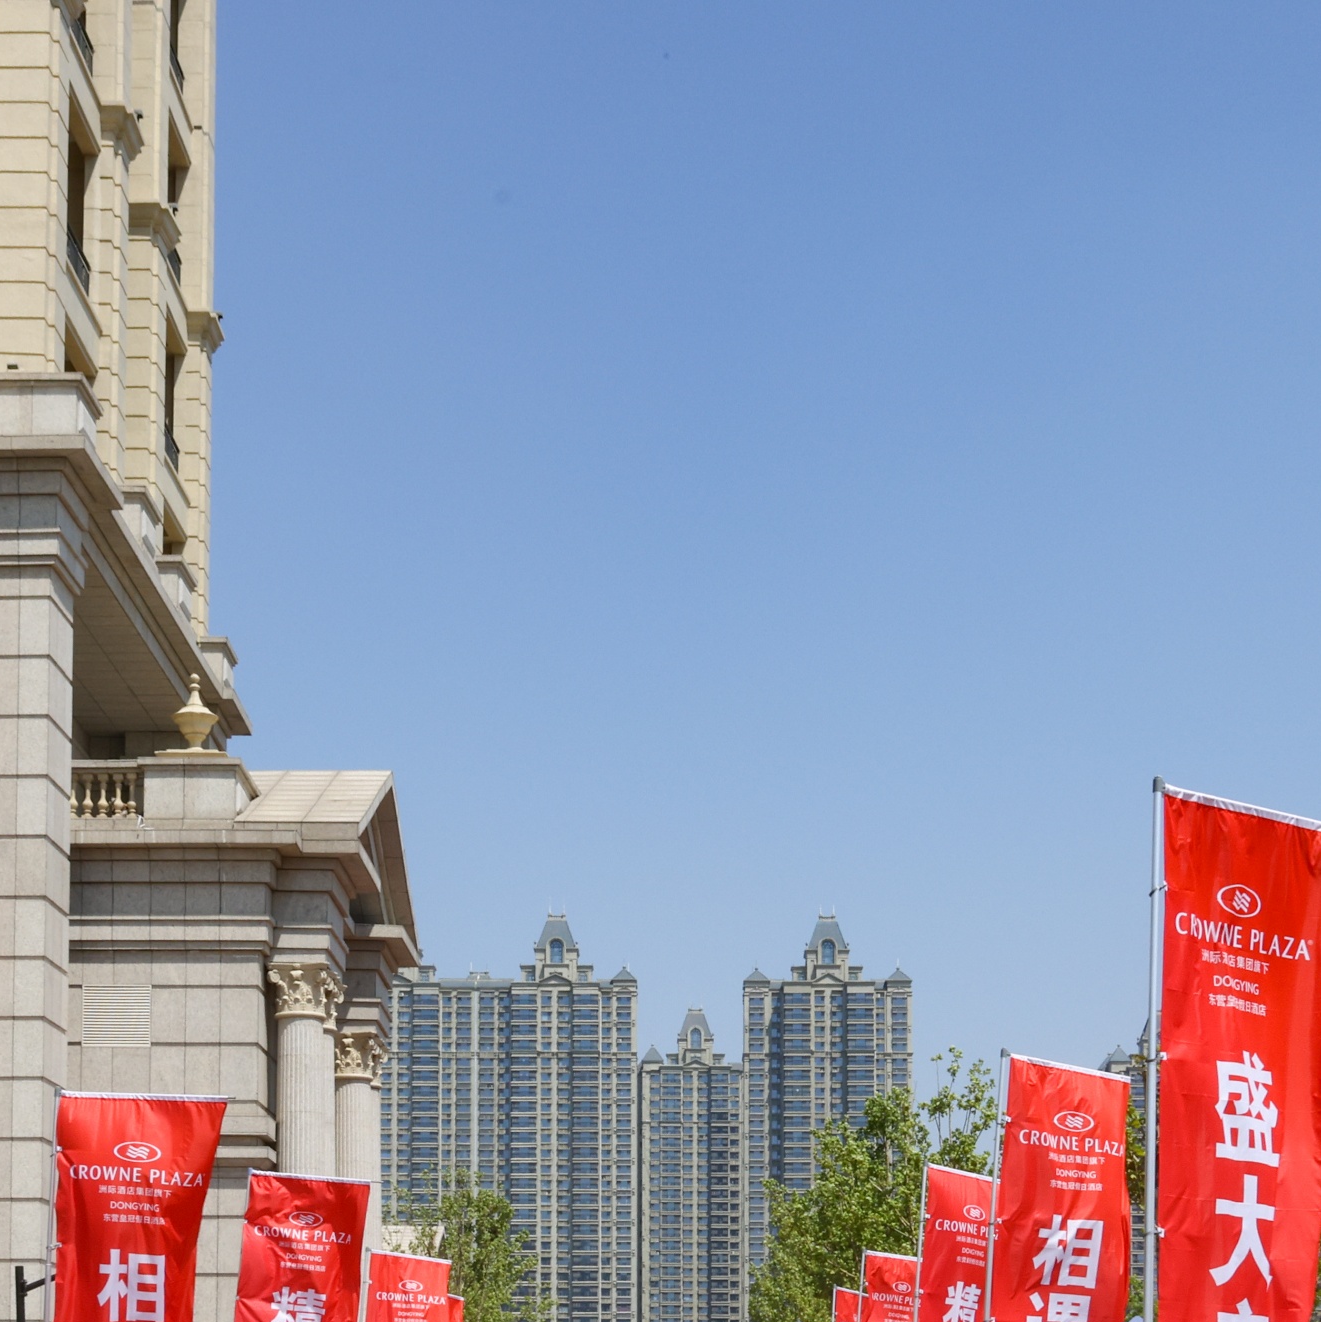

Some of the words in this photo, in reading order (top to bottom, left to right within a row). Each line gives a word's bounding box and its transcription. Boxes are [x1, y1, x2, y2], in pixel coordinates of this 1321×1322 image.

[1019, 1129, 1080, 1151] CROWNE
[70, 1164, 142, 1183] CROWNE
[150, 1169, 203, 1187] PLAZA
[110, 1201, 160, 1213] DONGYING
[254, 1225, 309, 1241] CROWNE
[314, 1230, 352, 1245] PLAZA
[935, 1218, 978, 1236] CROWNE
[376, 1291, 414, 1302] CROWNE
[417, 1294, 446, 1305] PLAZA
